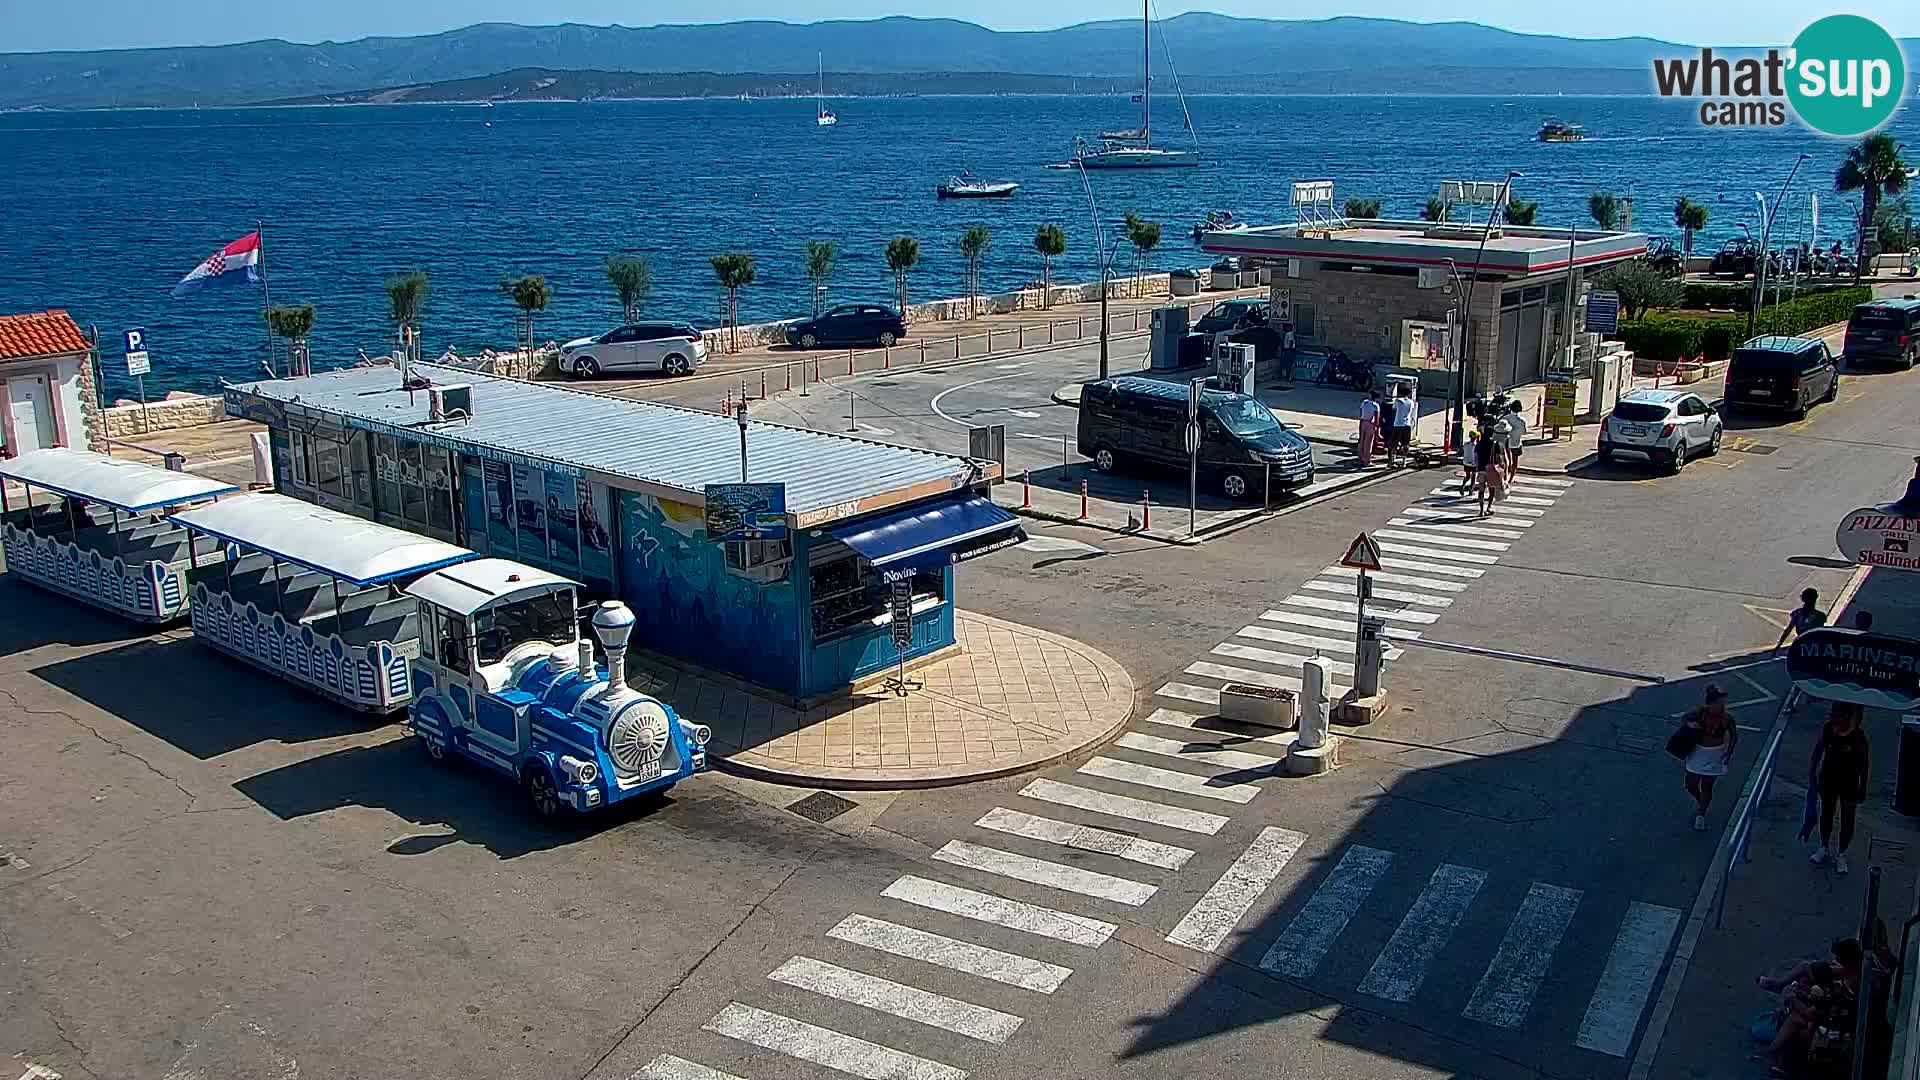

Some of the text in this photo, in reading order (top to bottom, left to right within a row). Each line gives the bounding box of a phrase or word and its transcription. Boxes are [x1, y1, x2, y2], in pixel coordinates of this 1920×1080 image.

[128, 331, 142, 350] P
[477, 446, 492, 458] BUS
[493, 449, 525, 465] STATION
[527, 458, 552, 471] TICKET
[554, 462, 581, 477] OFFICE
[1848, 515, 1920, 533] PIZZE
[883, 567, 917, 584] iNovine
[1869, 665, 1897, 681] bar
